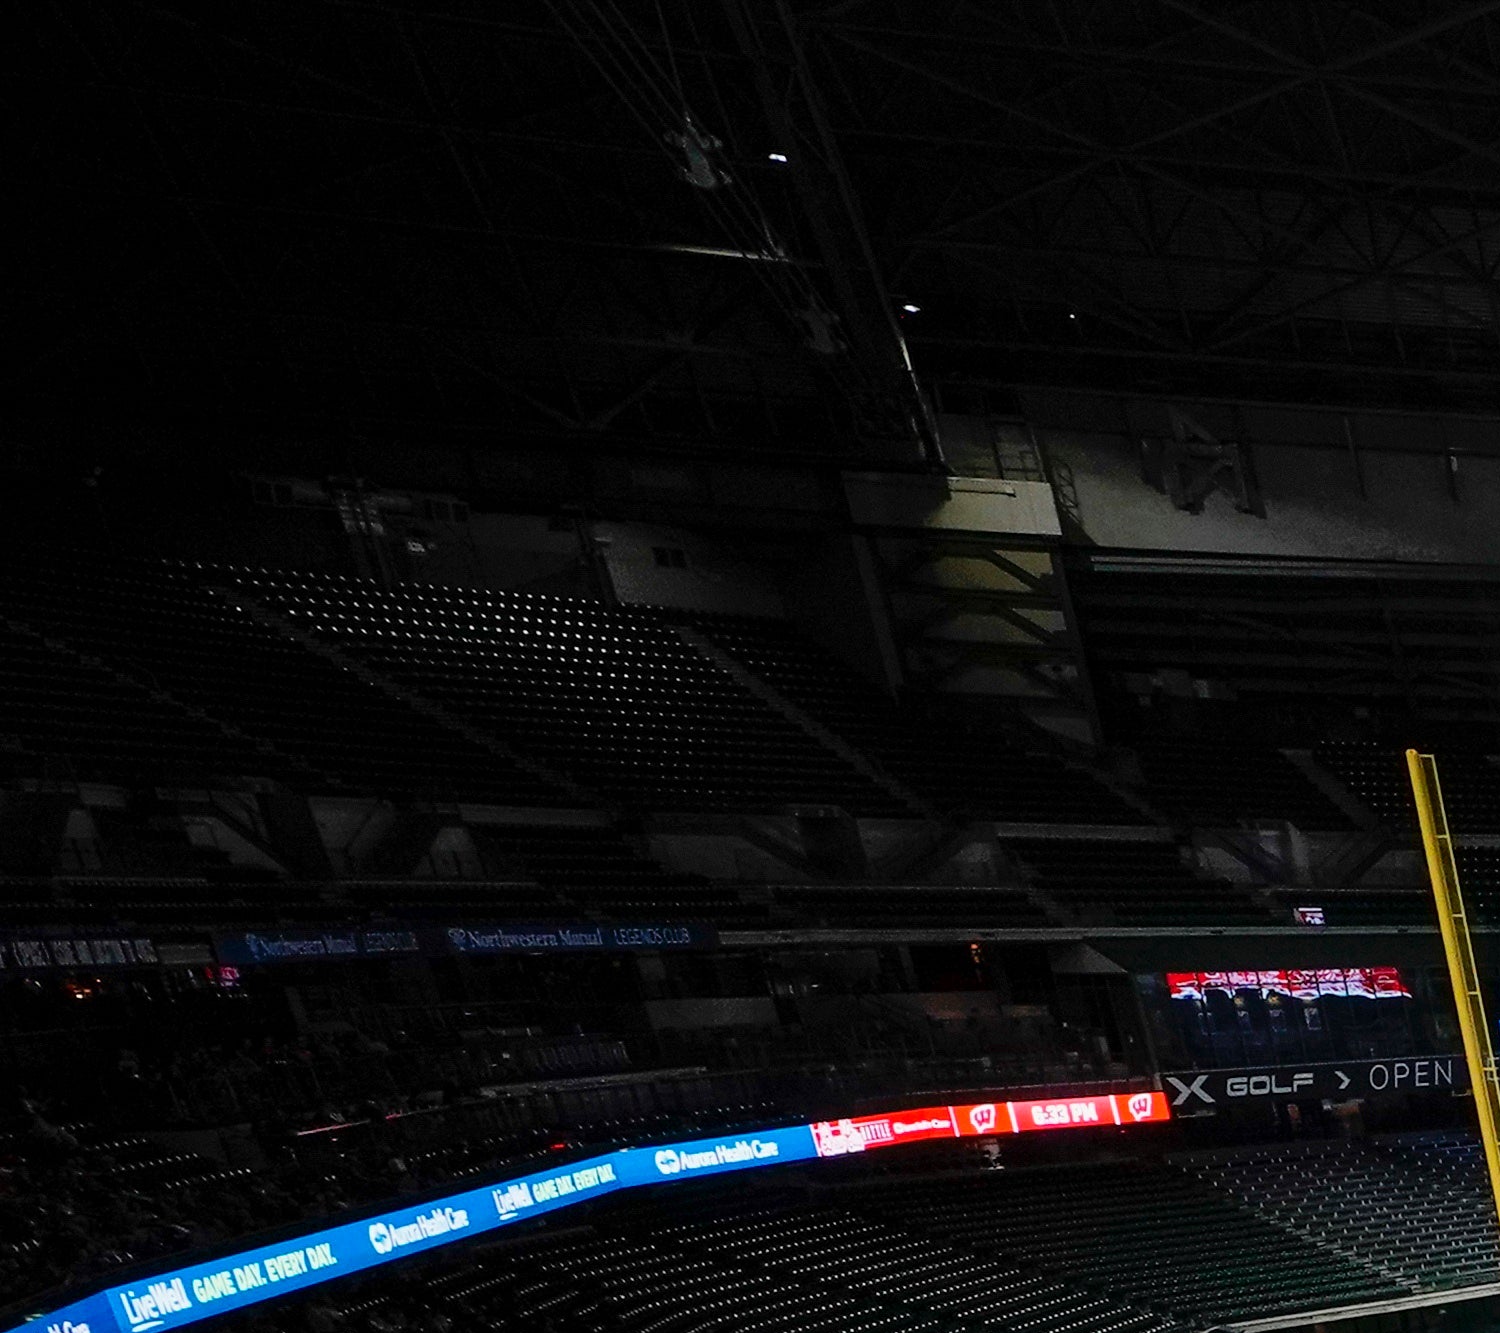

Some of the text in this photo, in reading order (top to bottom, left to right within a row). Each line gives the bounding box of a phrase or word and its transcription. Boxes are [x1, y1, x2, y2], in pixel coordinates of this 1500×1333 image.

[470, 928, 602, 949] Northwestern Mutual
[1165, 1073, 1314, 1106] X GOLF
[1368, 1060, 1453, 1090] OPEN
[679, 1140, 778, 1170] Aurora Health Care
[120, 1242, 337, 1325] LiveWell GAME DAY. EVERY DAY.
